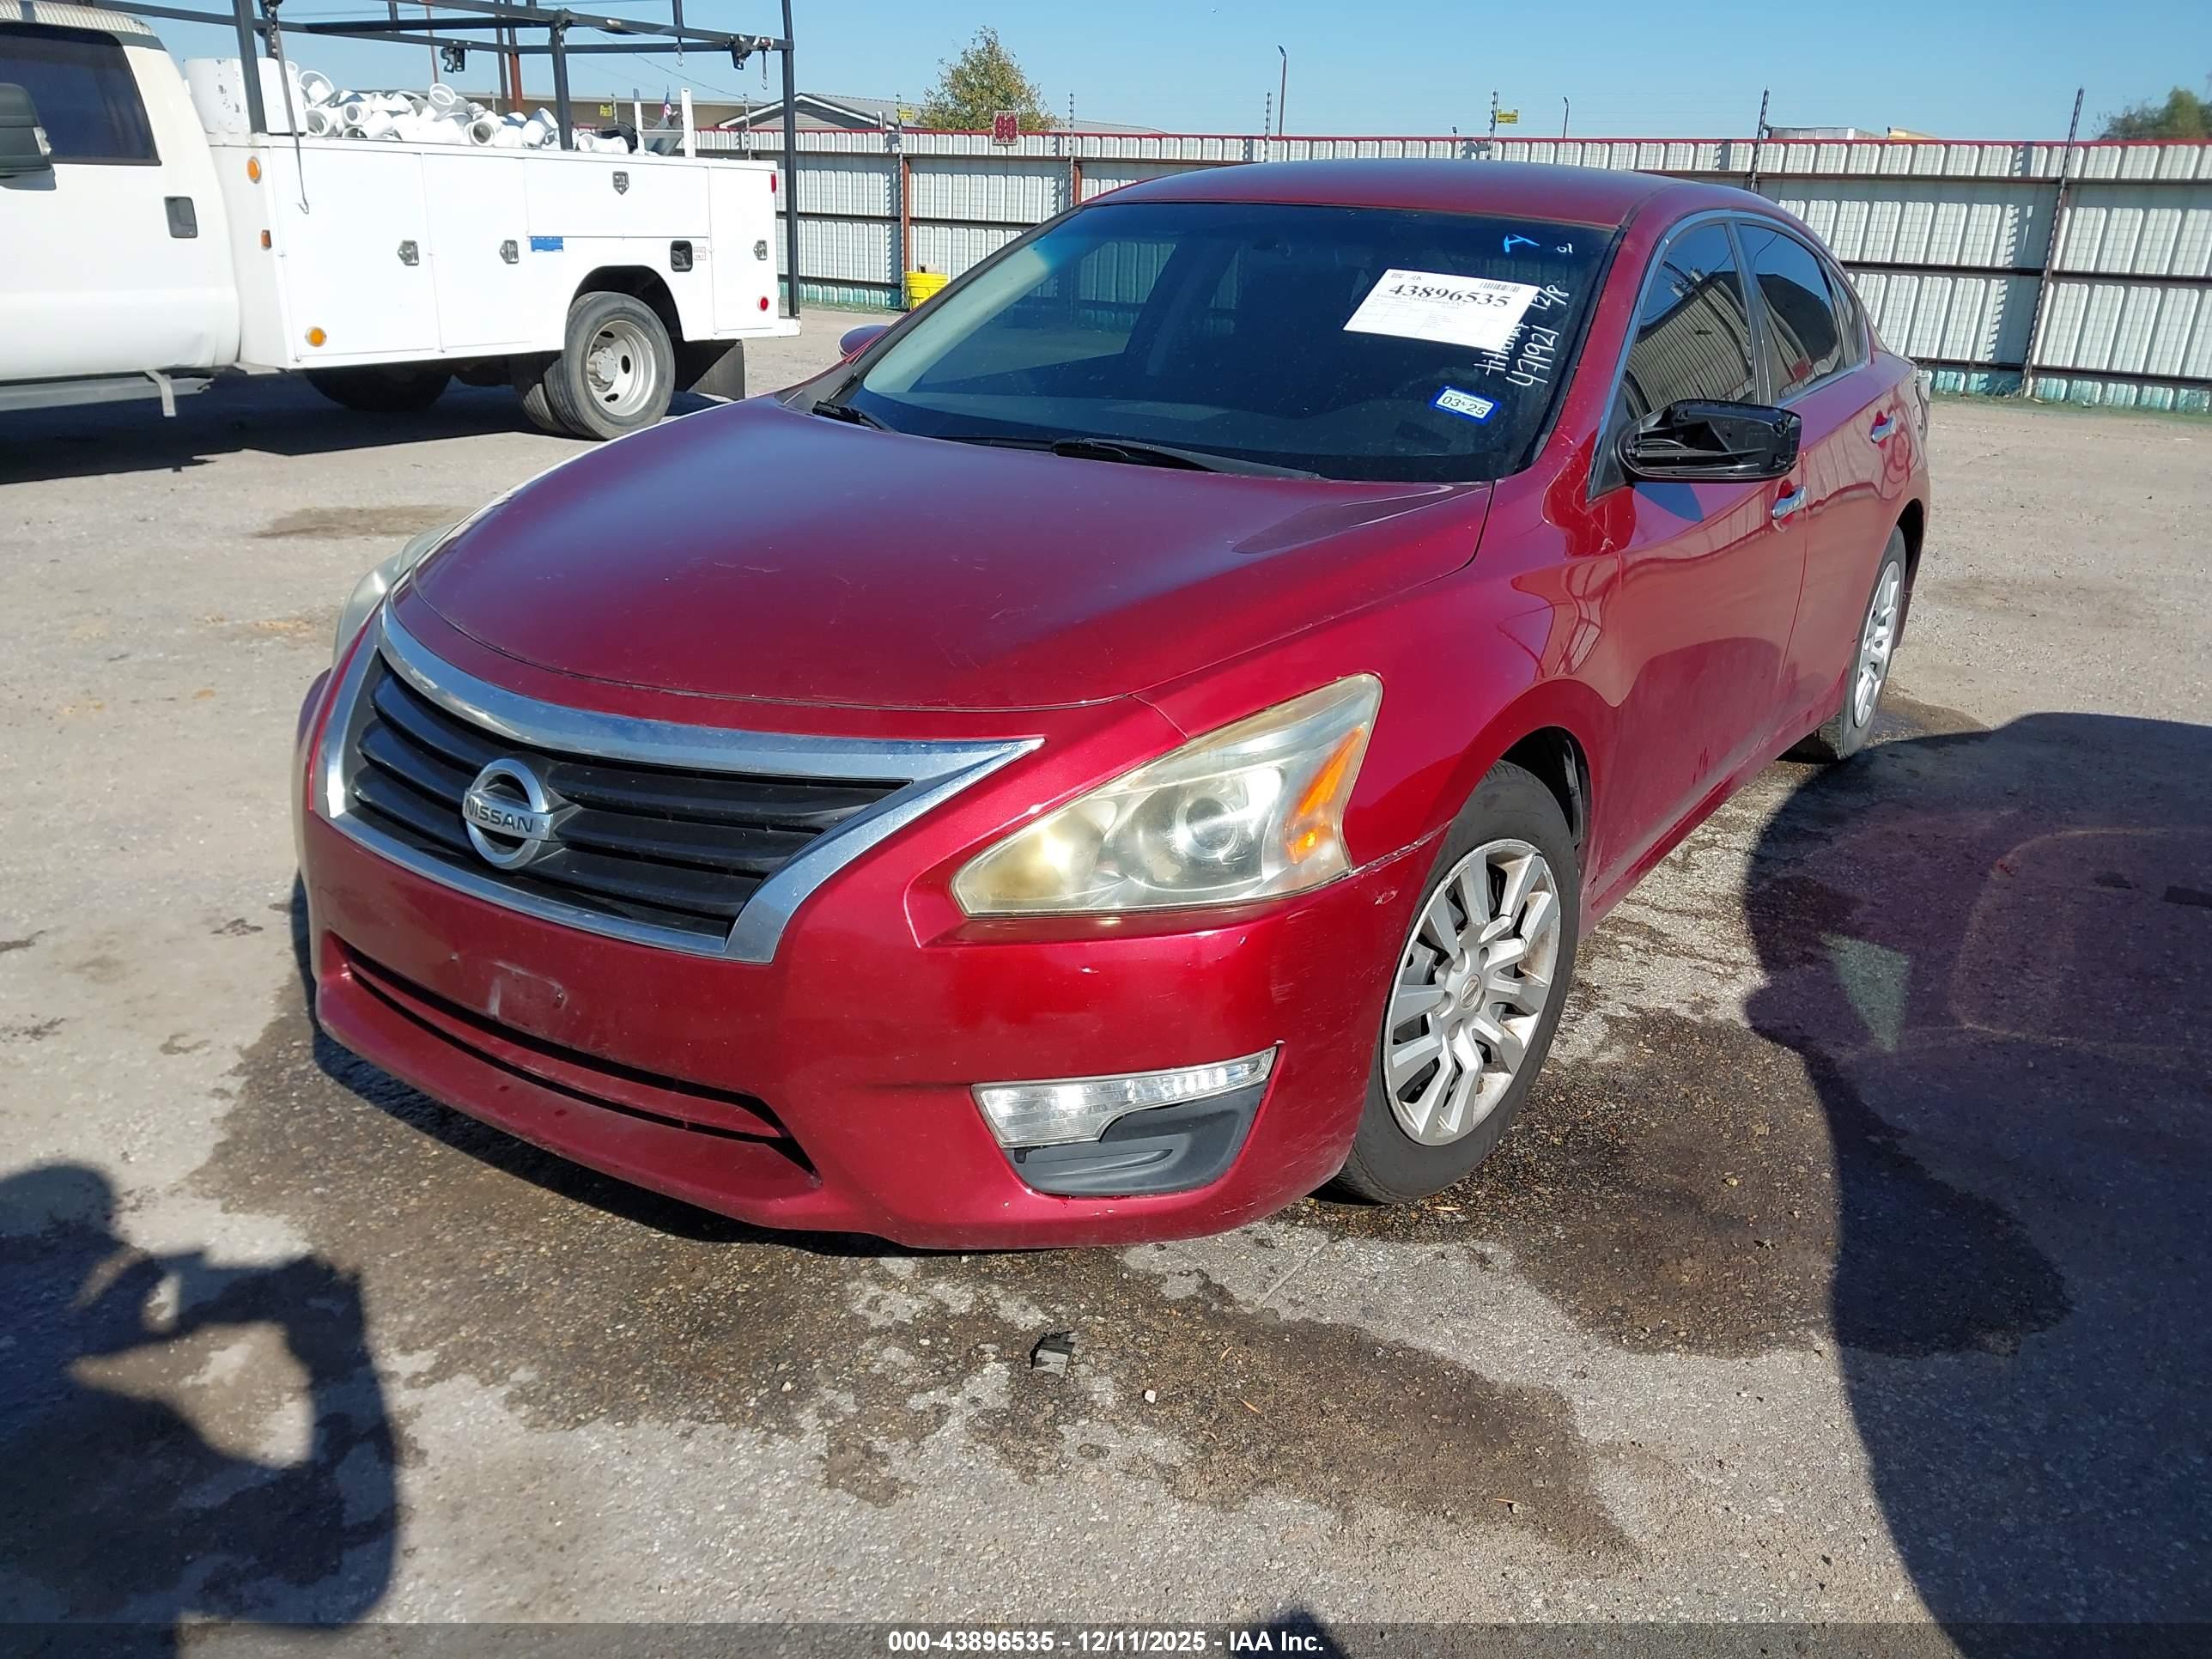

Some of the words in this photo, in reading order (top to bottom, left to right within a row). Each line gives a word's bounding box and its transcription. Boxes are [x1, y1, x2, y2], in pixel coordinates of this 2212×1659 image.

[1389, 283, 1511, 307] 43896535
[1443, 396, 1462, 407] 03
[1466, 403, 1487, 416] 25
[464, 798, 534, 834] NISSAN
